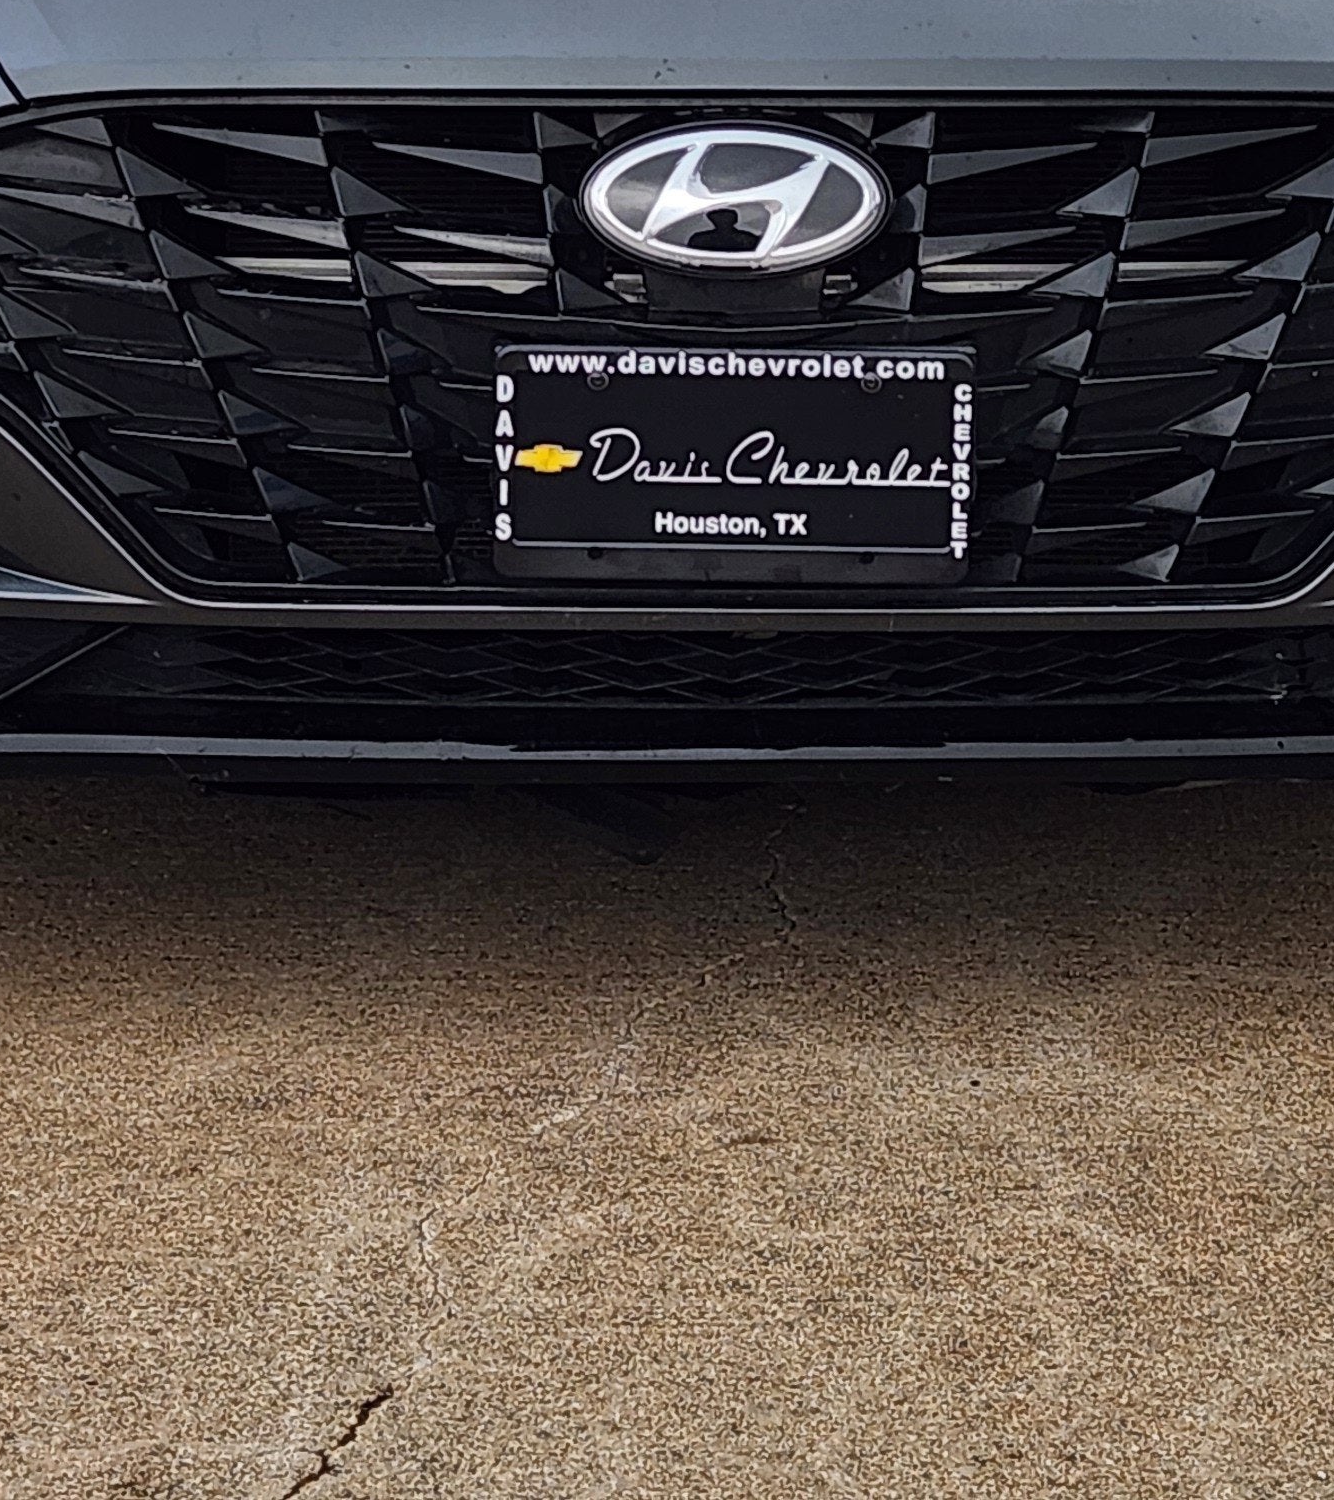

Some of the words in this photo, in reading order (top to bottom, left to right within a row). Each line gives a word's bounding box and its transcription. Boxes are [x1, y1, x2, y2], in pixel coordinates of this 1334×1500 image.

[528, 349, 946, 381] www.davischevrolet.com
[494, 374, 515, 542] DAVIS
[589, 427, 723, 484] Davis
[724, 430, 951, 487] Chevrolet
[950, 383, 973, 560] CHEVROLET
[654, 510, 767, 539] Houston,
[772, 512, 808, 536] TX
